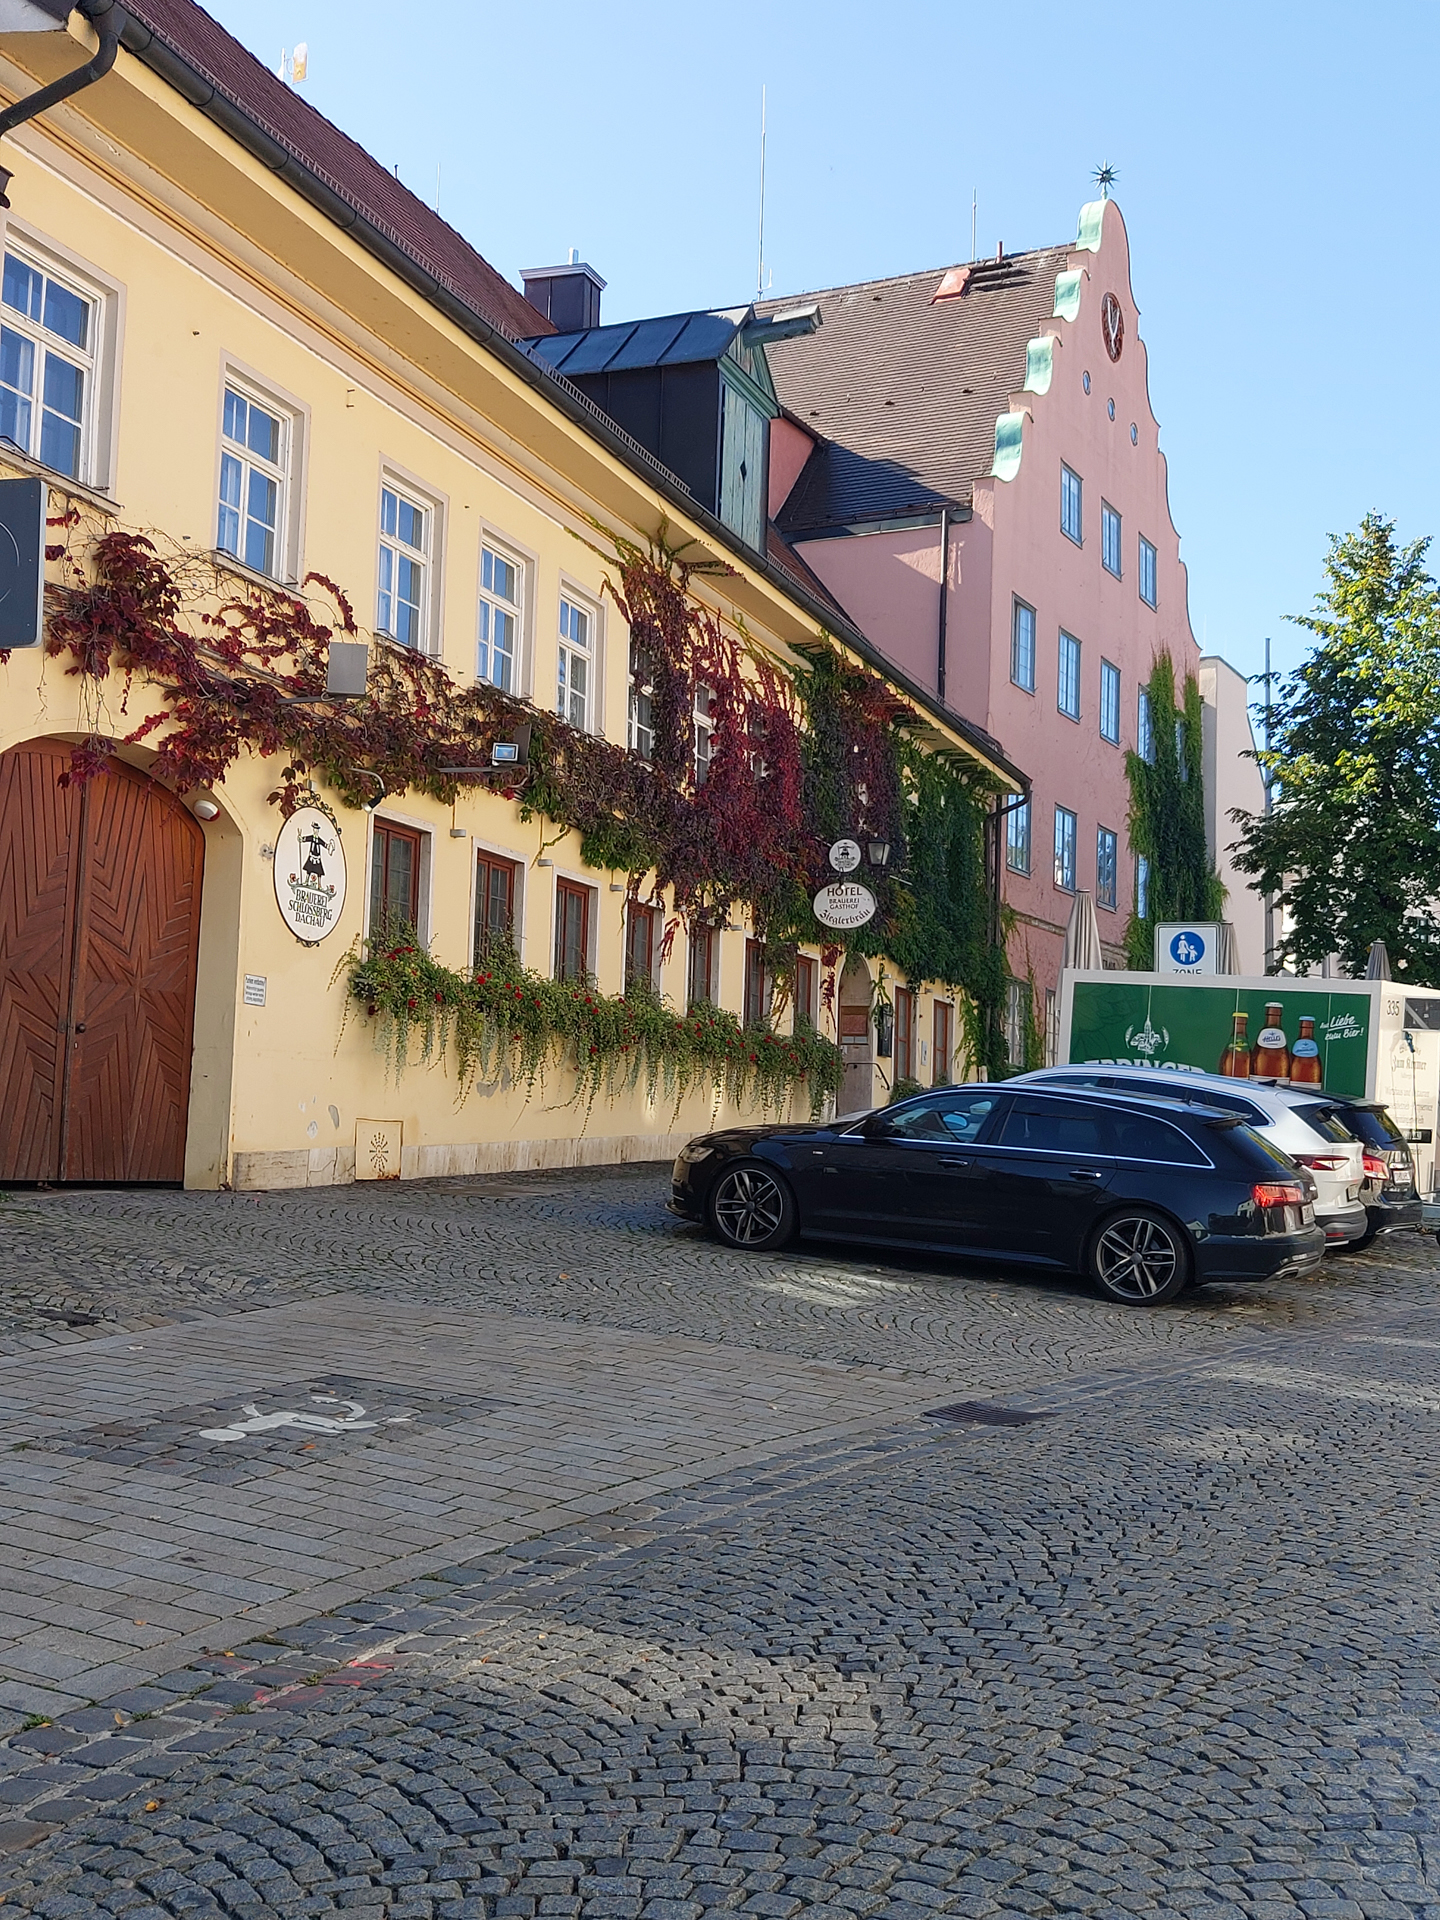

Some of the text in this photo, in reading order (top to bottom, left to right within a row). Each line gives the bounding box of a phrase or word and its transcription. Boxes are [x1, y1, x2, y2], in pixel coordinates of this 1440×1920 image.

[295, 889, 328, 908] BRAUEREI
[827, 887, 862, 896] HOTEL
[288, 899, 333, 921] SCHLOSSBERG
[819, 908, 871, 925] Zieglerbräu
[295, 912, 325, 928] DACHAU
[1387, 1000, 1399, 1016] 335
[1330, 1013, 1356, 1028] Liebe
[1343, 1027, 1364, 1039] Bier!
